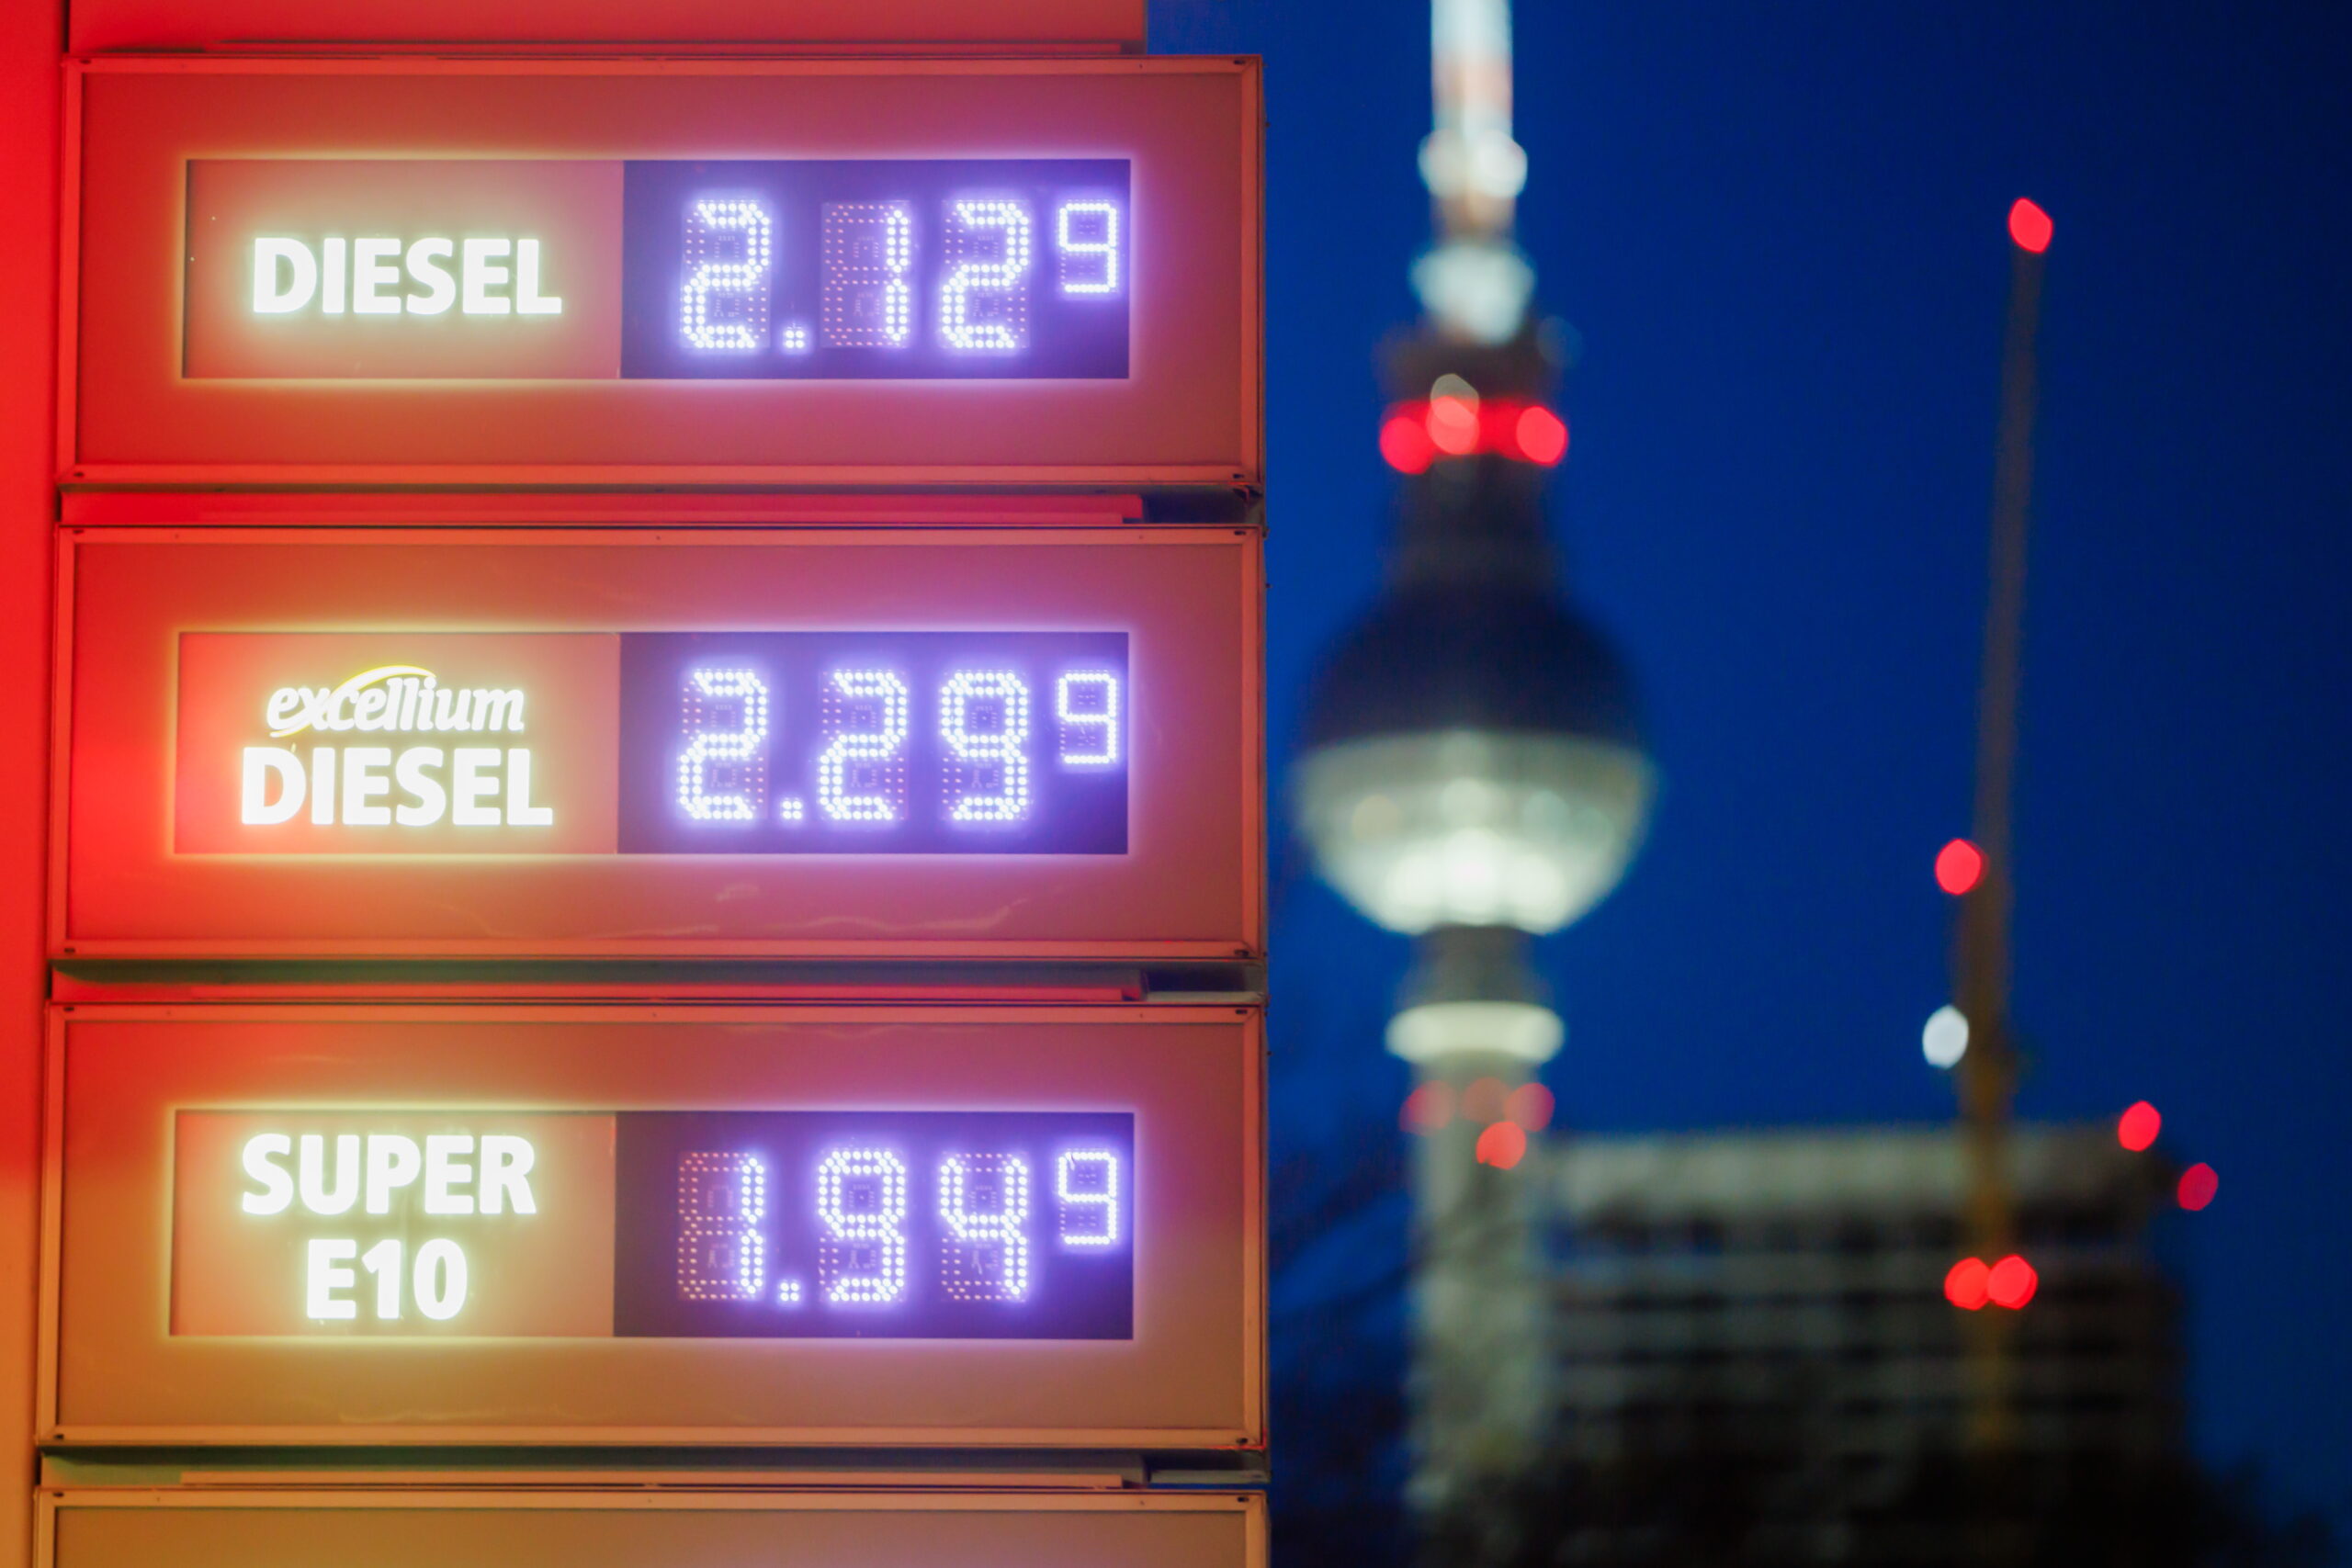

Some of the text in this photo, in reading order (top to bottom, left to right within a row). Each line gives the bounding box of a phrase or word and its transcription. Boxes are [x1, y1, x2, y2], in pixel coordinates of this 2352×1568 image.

[254, 237, 561, 314] DIESEL
[266, 676, 525, 732] excellium
[242, 747, 553, 826] DIESEL
[242, 1134, 537, 1214] SUPER
[307, 1238, 467, 1320] E10
